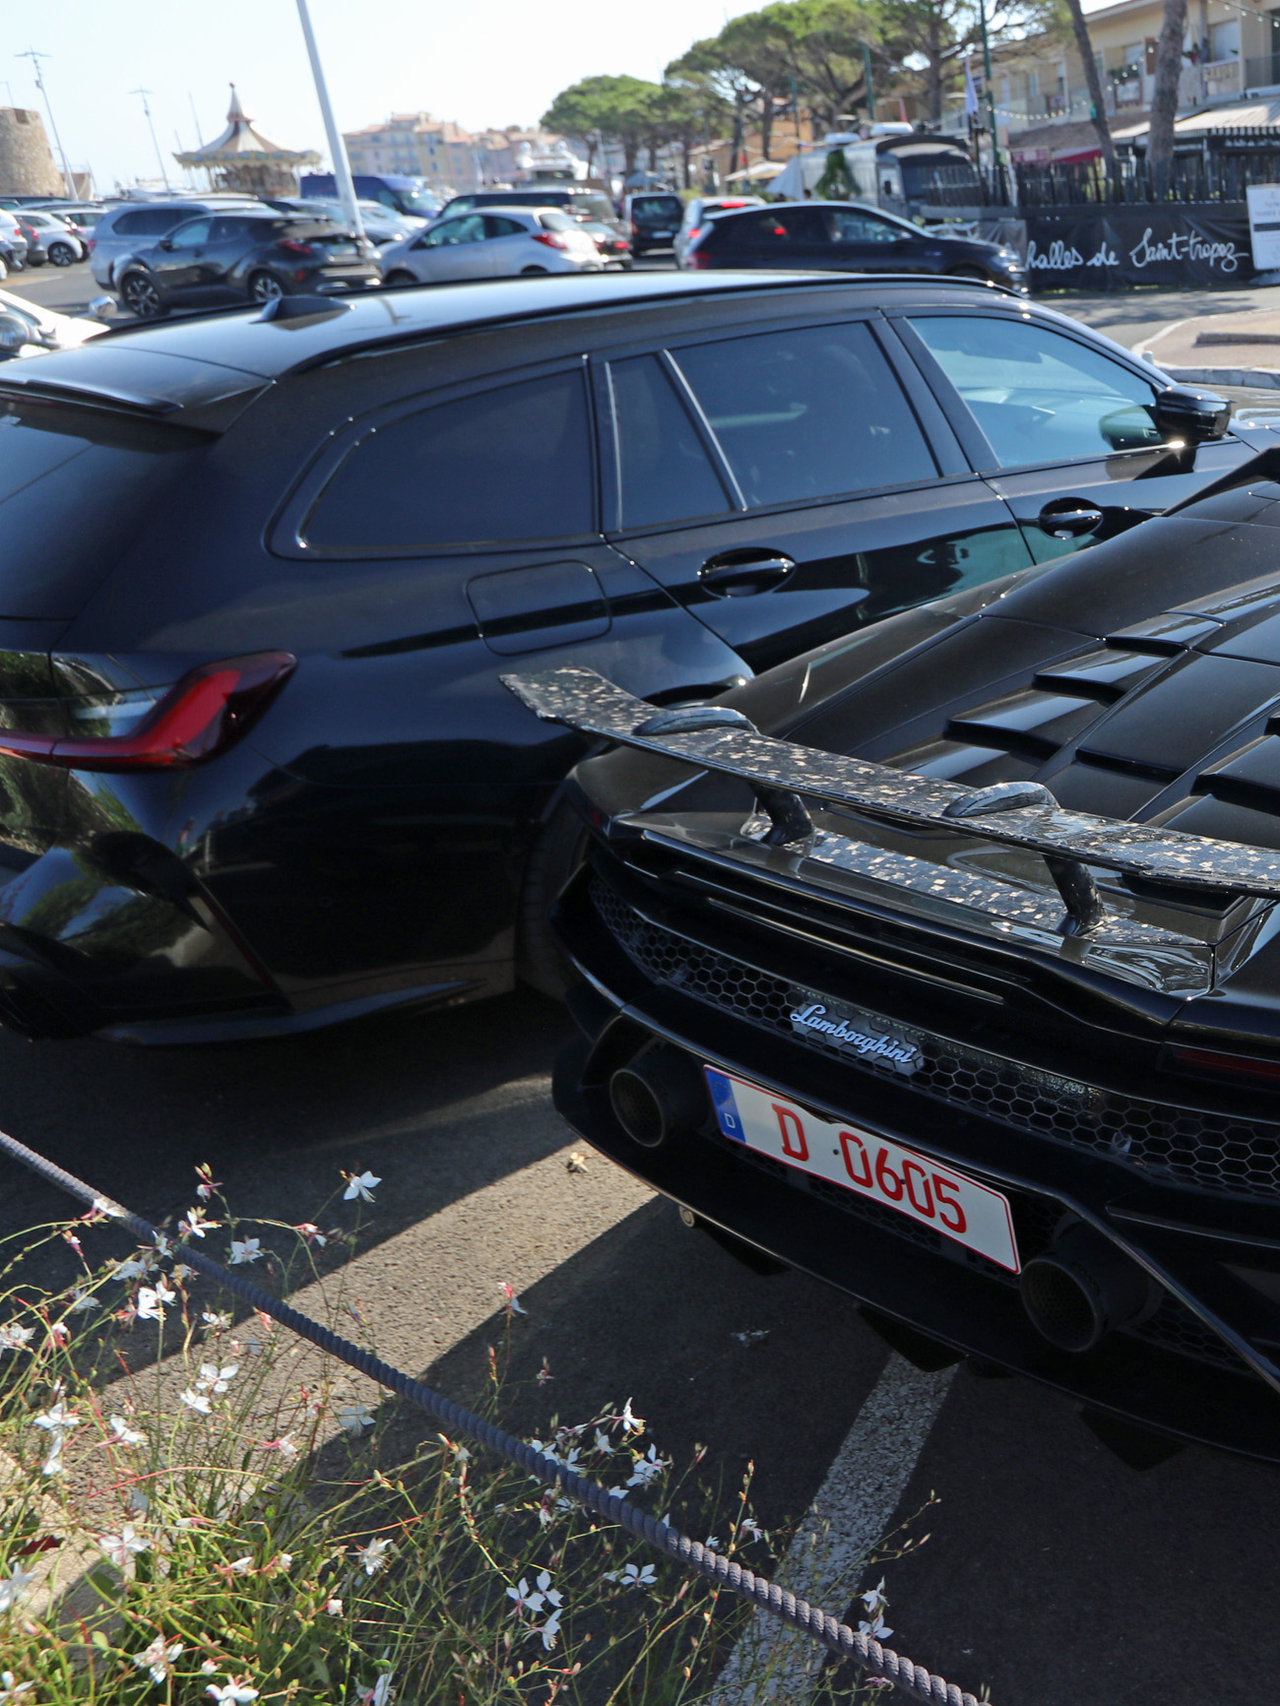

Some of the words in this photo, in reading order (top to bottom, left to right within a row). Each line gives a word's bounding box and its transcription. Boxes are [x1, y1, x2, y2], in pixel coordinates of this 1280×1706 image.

[1086, 241, 1120, 267] de
[789, 1004, 918, 1063] Lamborghini
[724, 1112, 737, 1130] D
[771, 1102, 810, 1163] D
[838, 1130, 967, 1234] 0605
